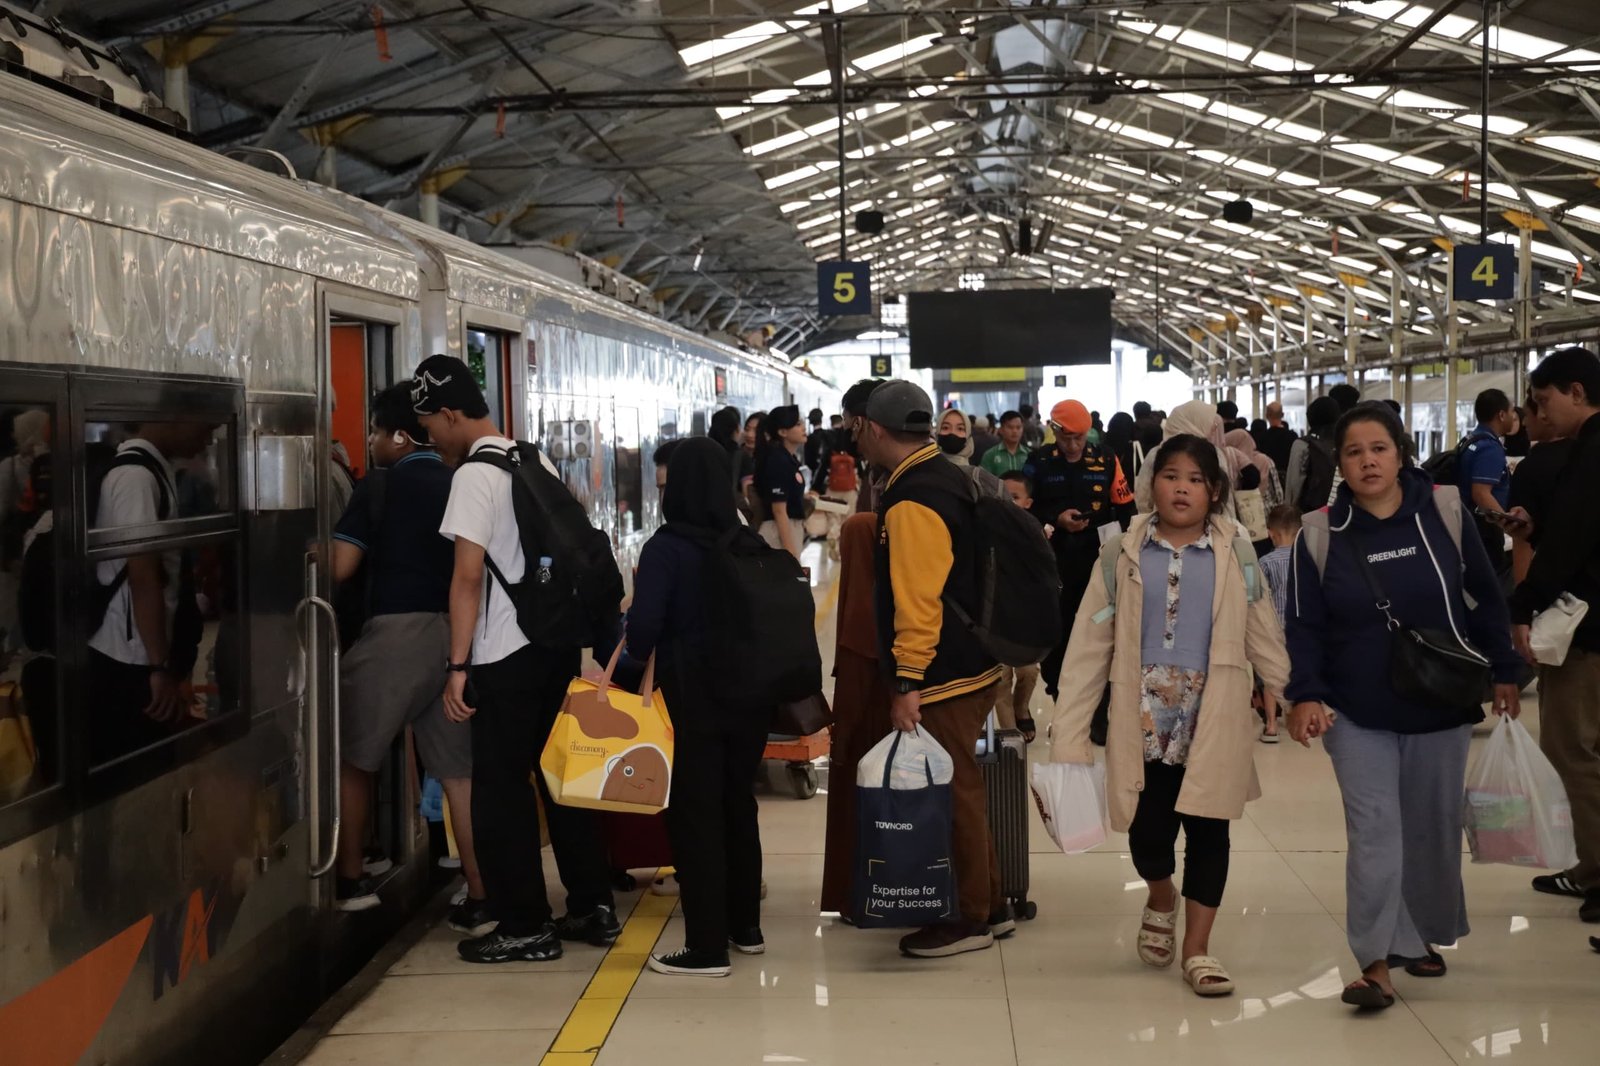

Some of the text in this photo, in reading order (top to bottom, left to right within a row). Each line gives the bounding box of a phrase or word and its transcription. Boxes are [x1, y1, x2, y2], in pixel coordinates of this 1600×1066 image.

[1472, 256, 1498, 287] 4
[833, 272, 856, 303] 5
[876, 359, 886, 374] 5
[1152, 354, 1164, 368] 4
[1367, 546, 1416, 563] GREENLIGHT
[872, 884, 936, 897] Expertise for
[871, 898, 942, 908] your Success
